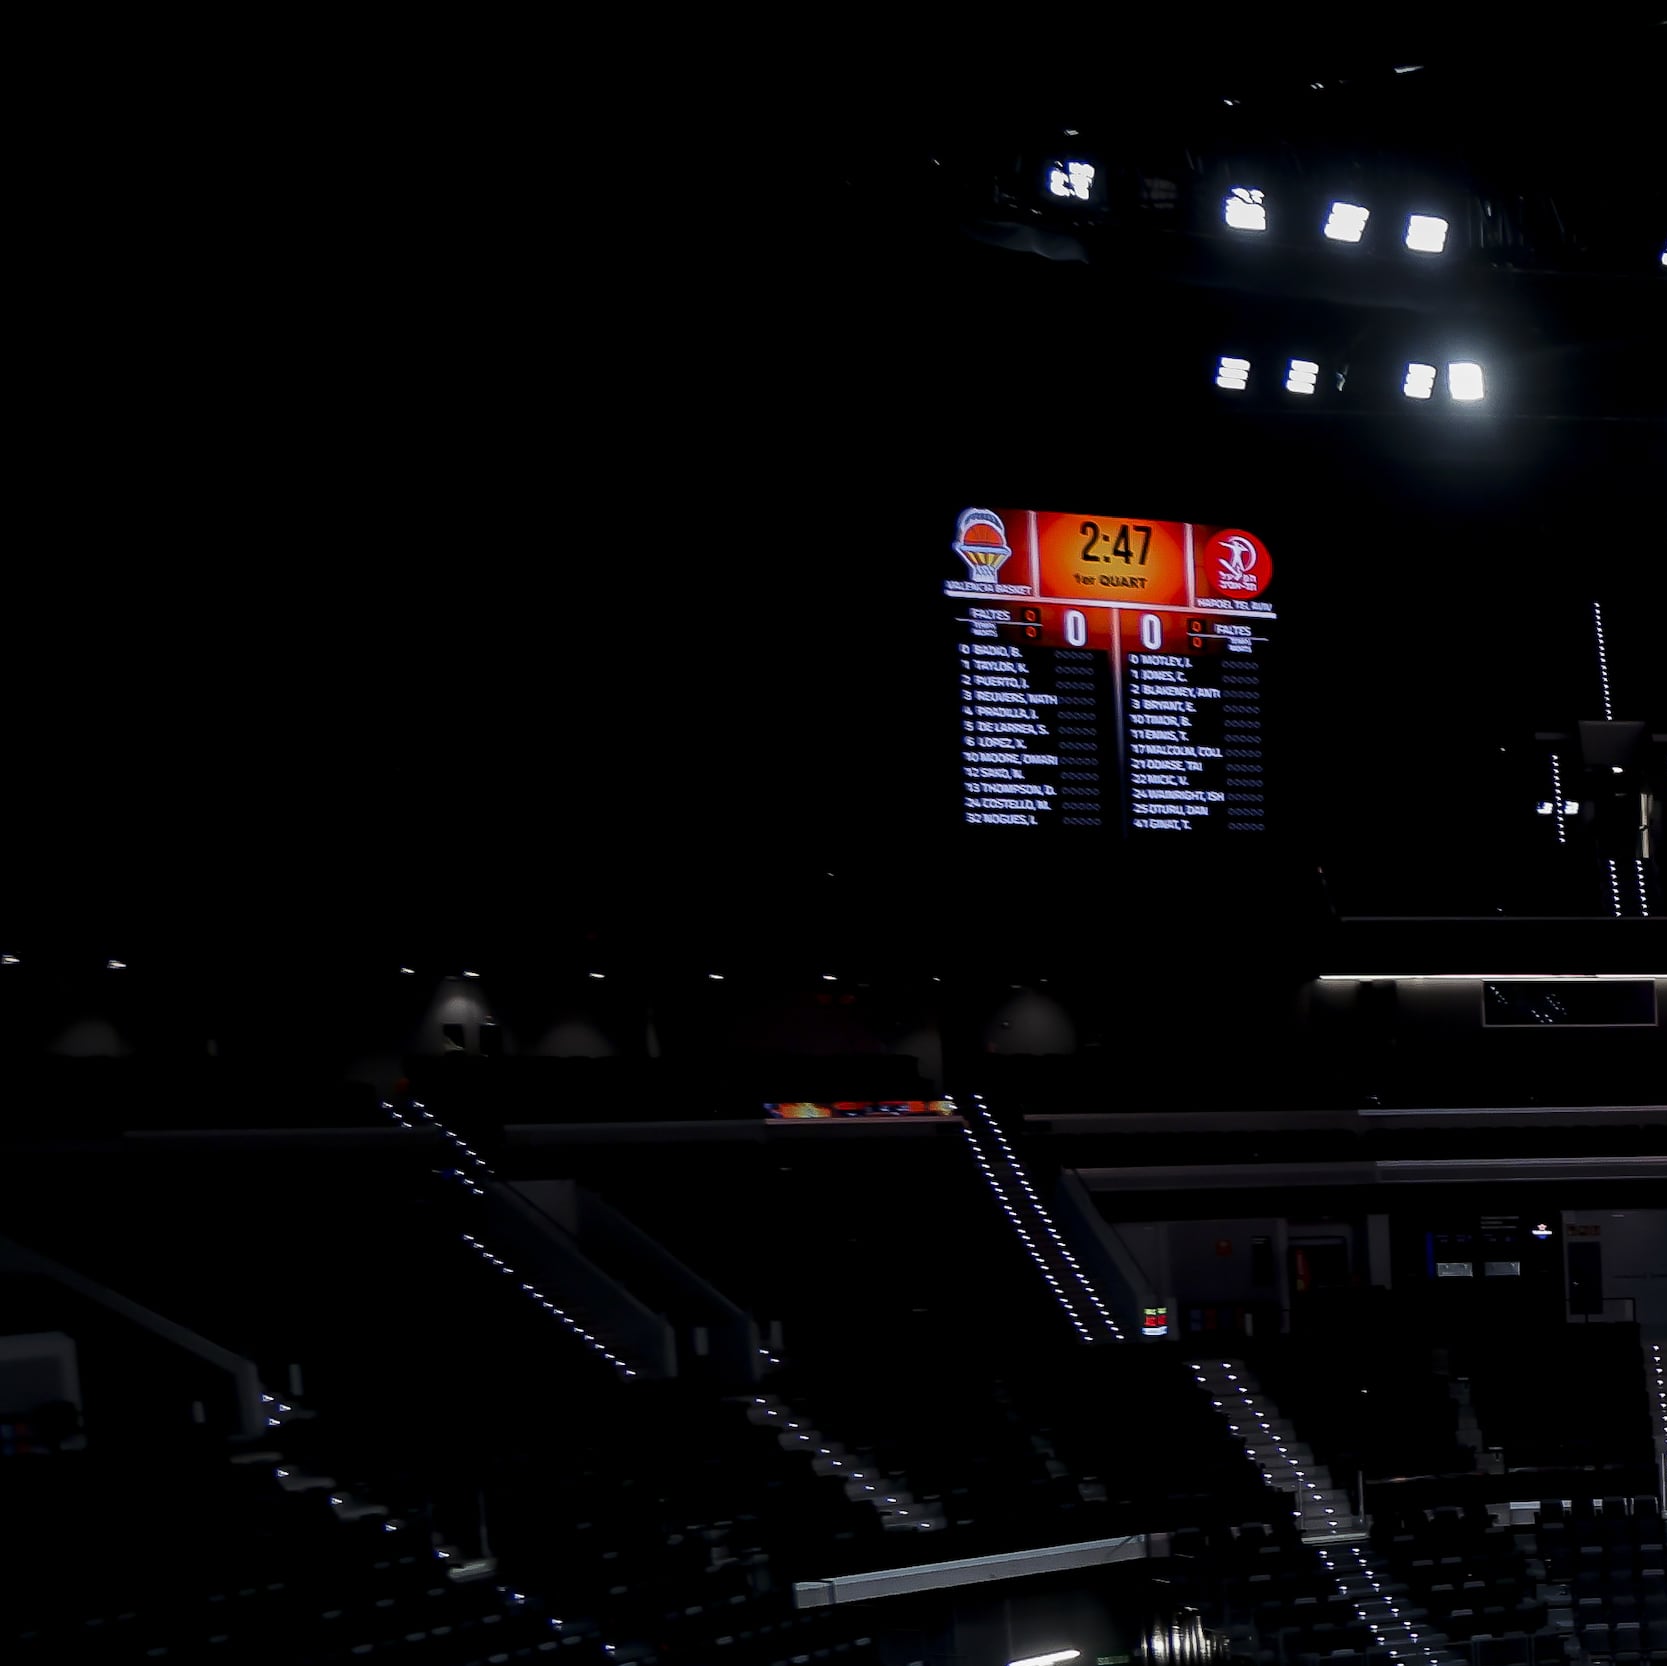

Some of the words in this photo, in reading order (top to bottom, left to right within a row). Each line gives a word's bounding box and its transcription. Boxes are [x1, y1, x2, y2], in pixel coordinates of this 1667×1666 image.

[1080, 521, 1152, 565] 2:47
[1100, 575, 1148, 588] QUART
[1065, 609, 1086, 647] 0
[1142, 614, 1162, 650] 0
